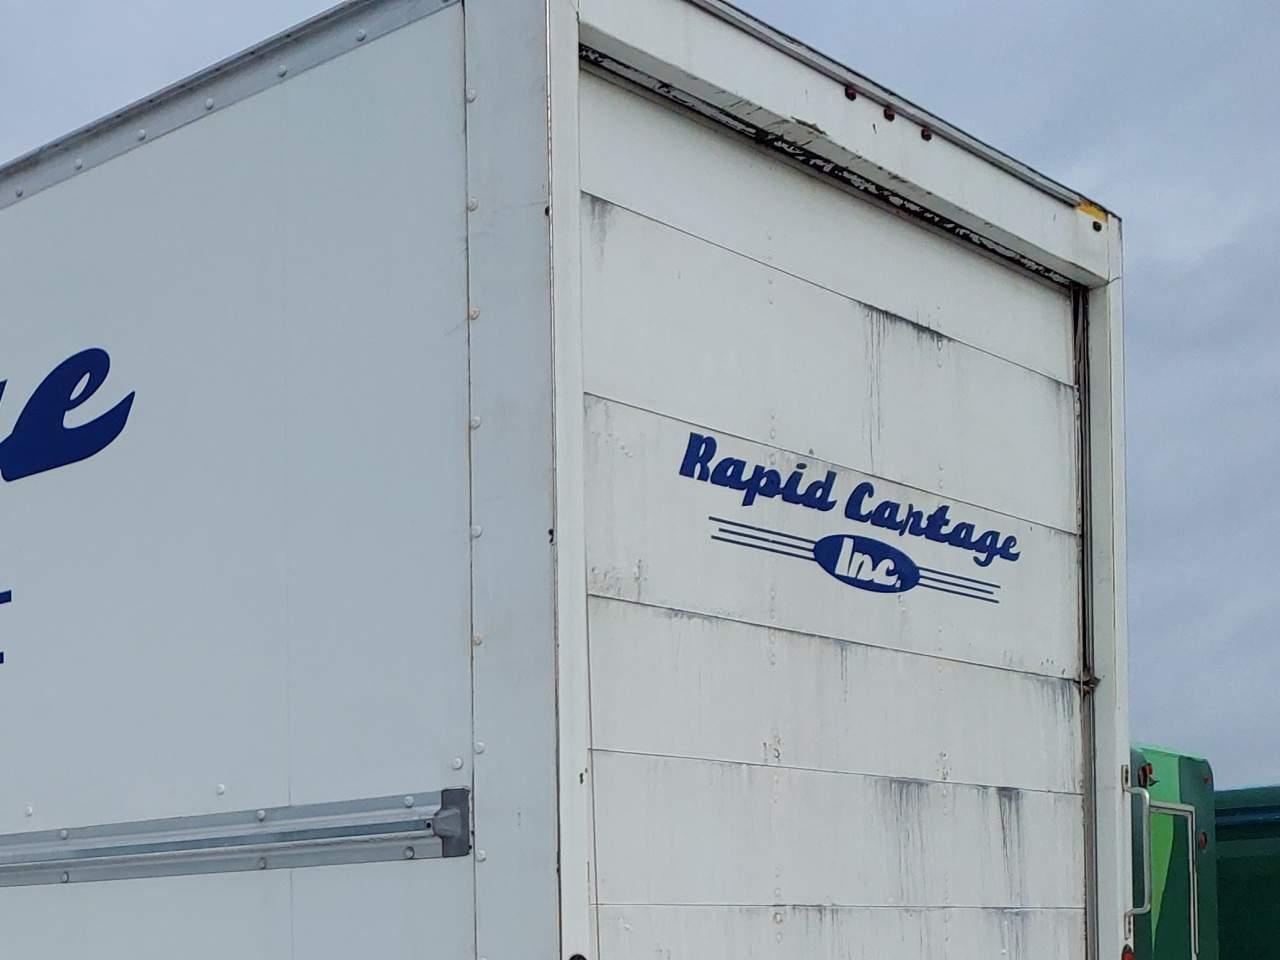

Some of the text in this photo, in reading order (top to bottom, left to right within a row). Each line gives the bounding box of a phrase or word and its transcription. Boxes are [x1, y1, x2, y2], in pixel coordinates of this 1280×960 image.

[678, 432, 1020, 567] Rapid Cartage
[834, 536, 902, 588] Inc.
